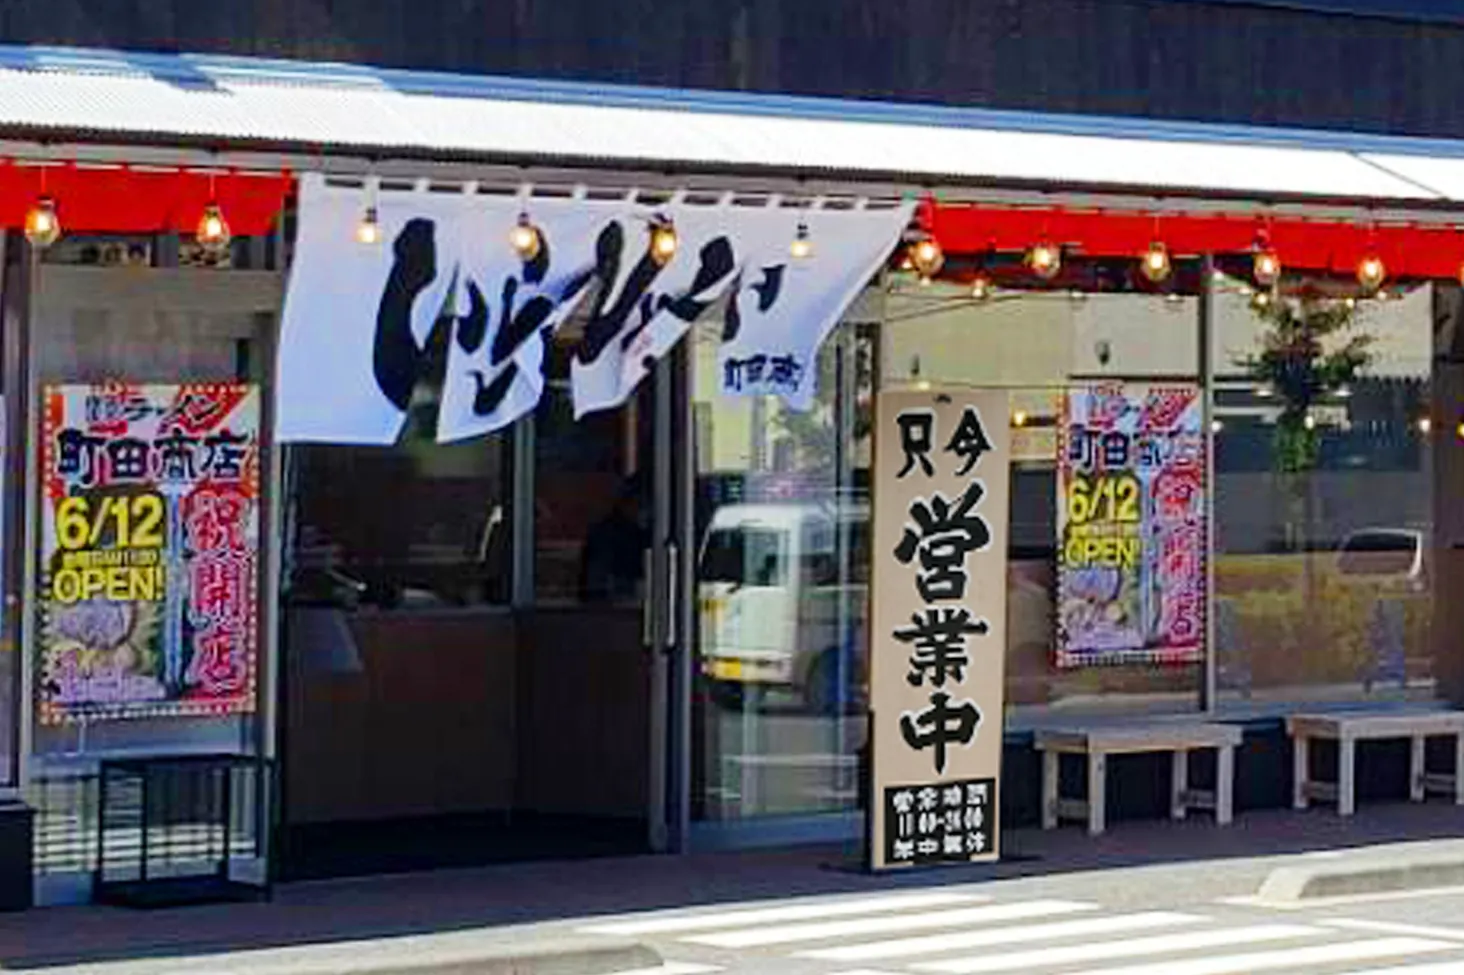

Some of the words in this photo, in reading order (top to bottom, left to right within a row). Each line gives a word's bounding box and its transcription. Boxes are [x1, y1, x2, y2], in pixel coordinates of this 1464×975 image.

[56, 428, 250, 485] 町田商店
[895, 408, 993, 479] 只今
[56, 495, 164, 550] 6/12
[1069, 476, 1139, 524] 6/12
[53, 566, 163, 604] OPEN!
[893, 481, 990, 776] 営業中
